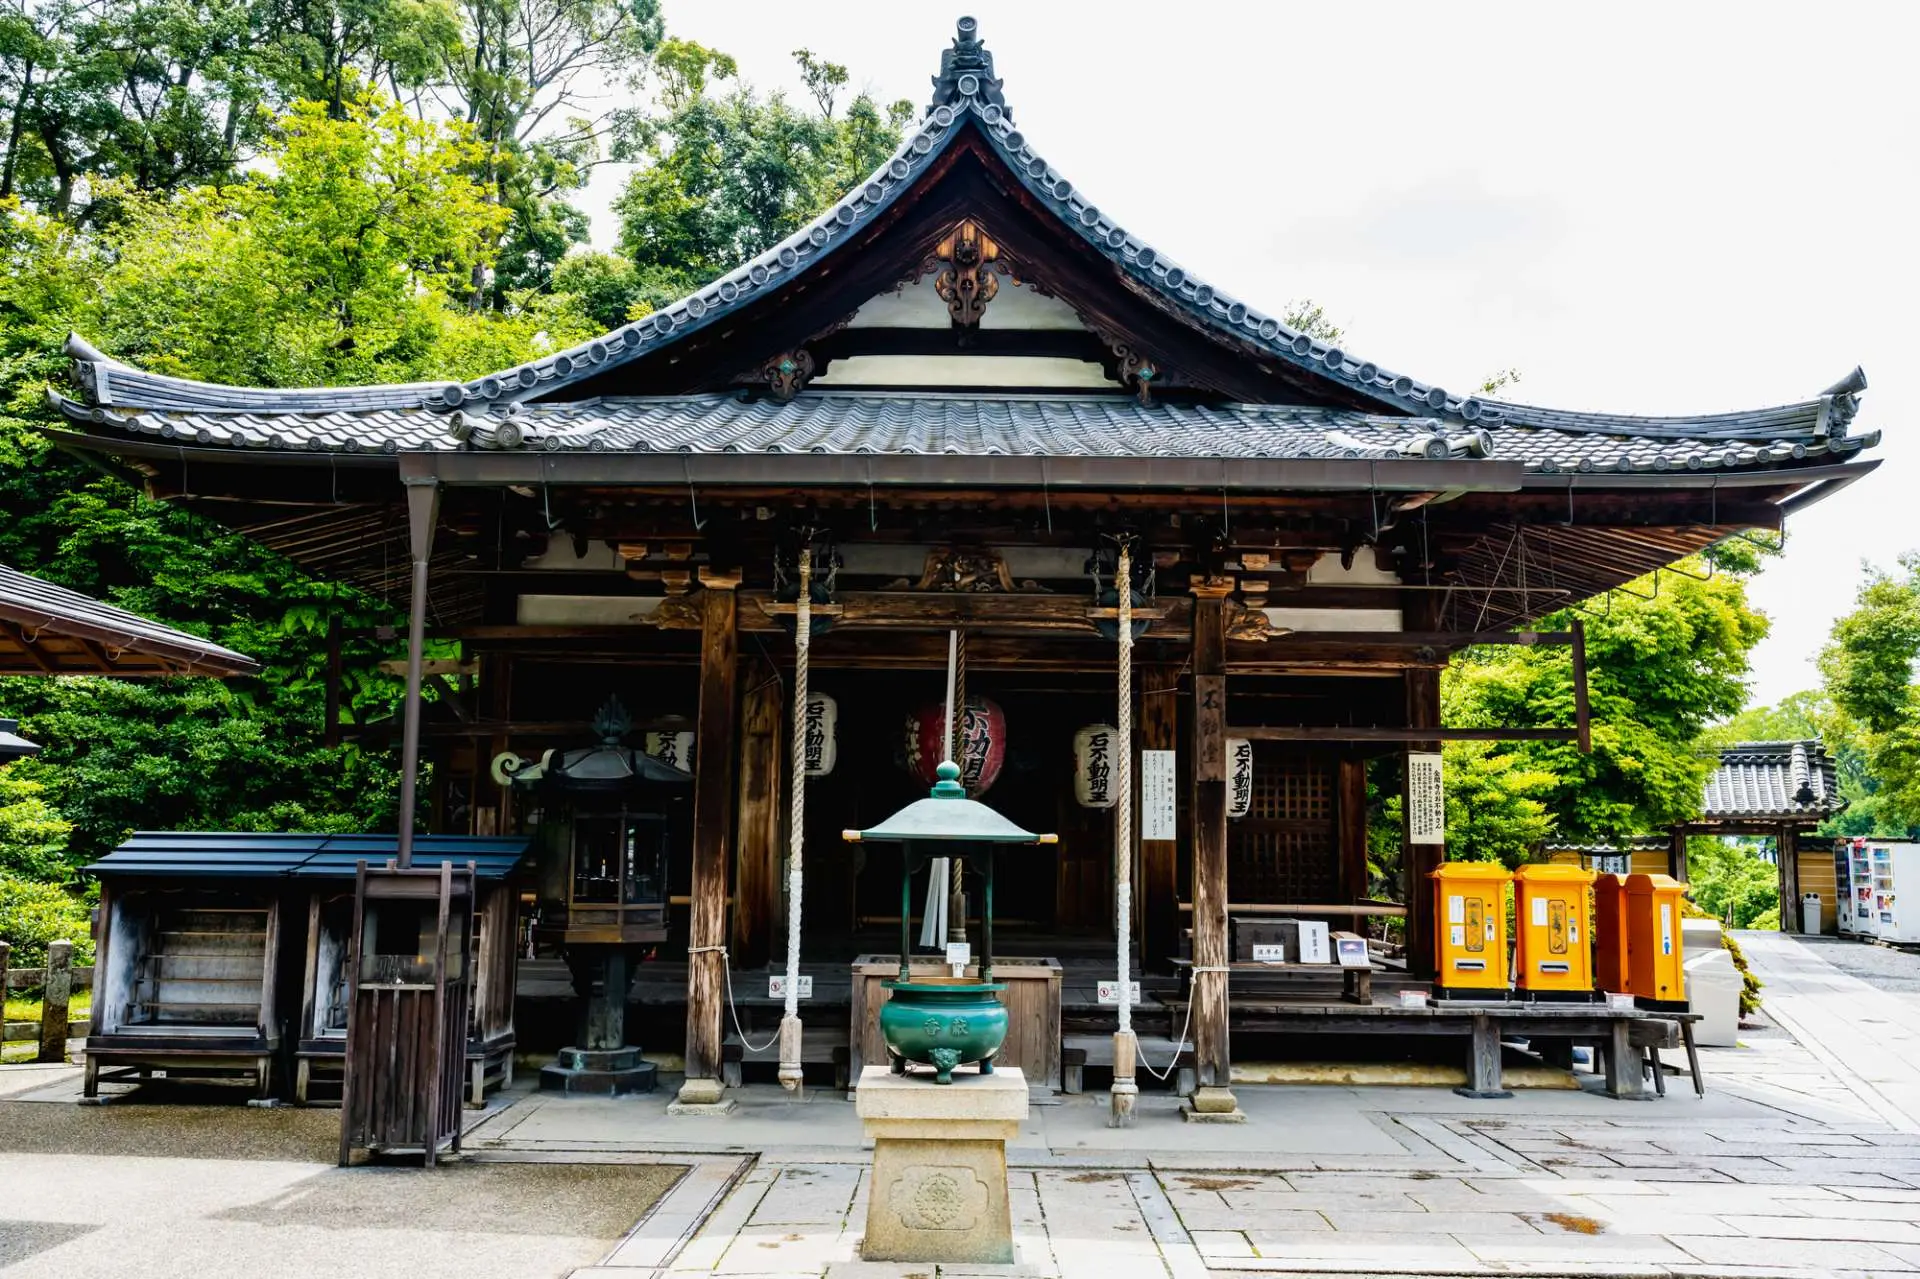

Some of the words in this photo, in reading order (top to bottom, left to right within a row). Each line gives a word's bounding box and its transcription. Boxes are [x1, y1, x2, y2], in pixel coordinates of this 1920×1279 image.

[1087, 732, 1110, 803] 石不動明王
[1229, 744, 1251, 813] 石不動明王
